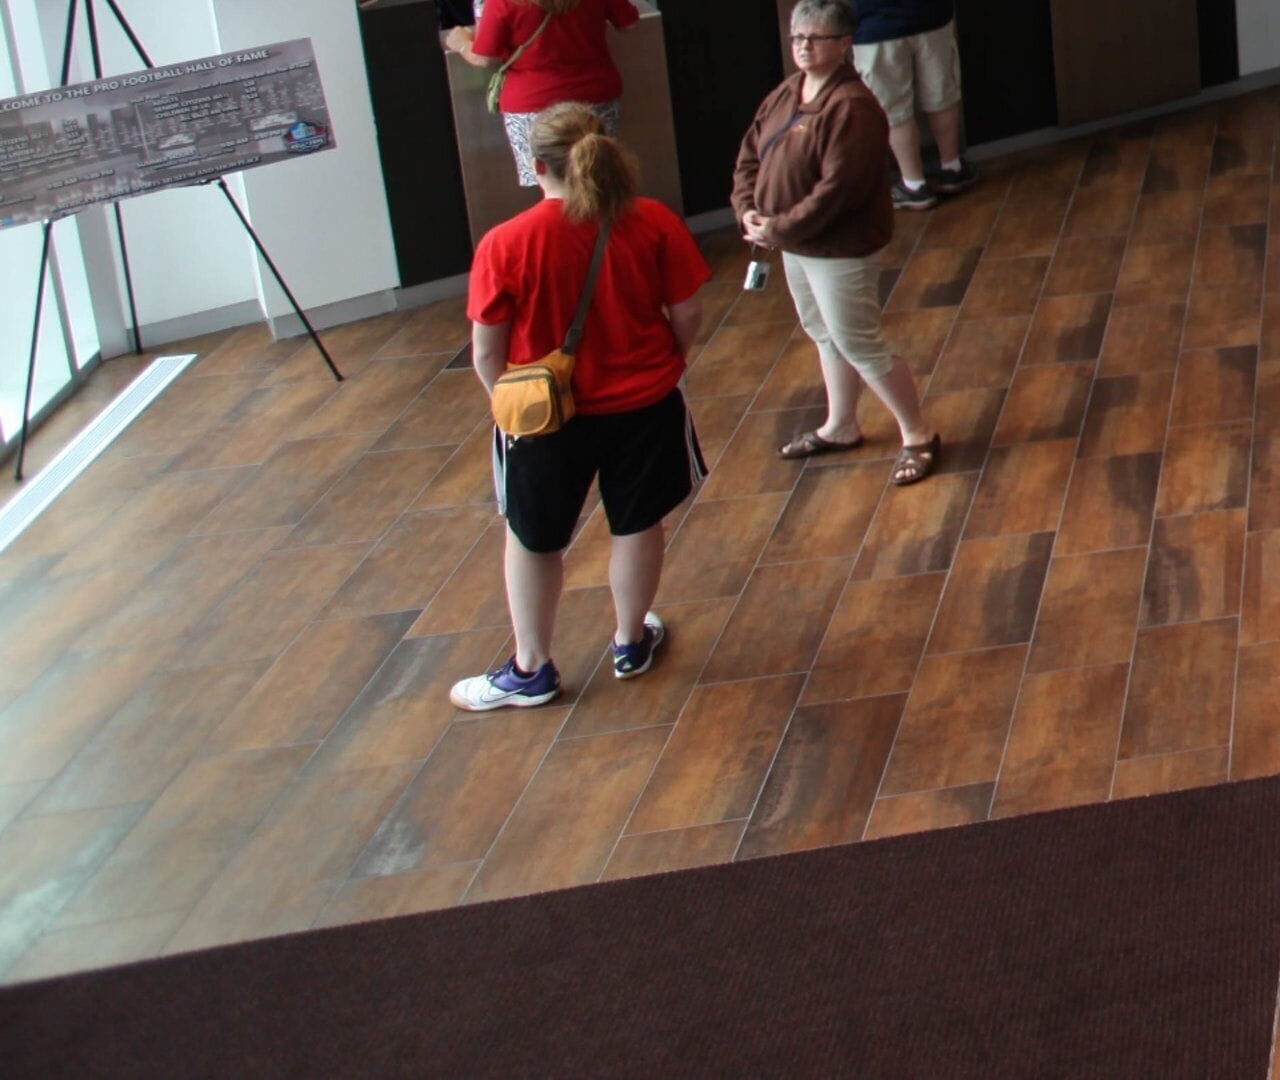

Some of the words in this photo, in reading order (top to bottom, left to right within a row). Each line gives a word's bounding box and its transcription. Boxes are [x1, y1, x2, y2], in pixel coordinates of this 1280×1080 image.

[0, 95, 39, 113] COME
[45, 91, 63, 103] TO
[66, 86, 91, 100] THE
[94, 80, 120, 94] PRO
[122, 67, 183, 88] FOOTBALL
[186, 62, 216, 75] HALL
[218, 56, 234, 69] OF
[236, 48, 270, 65] FAME
